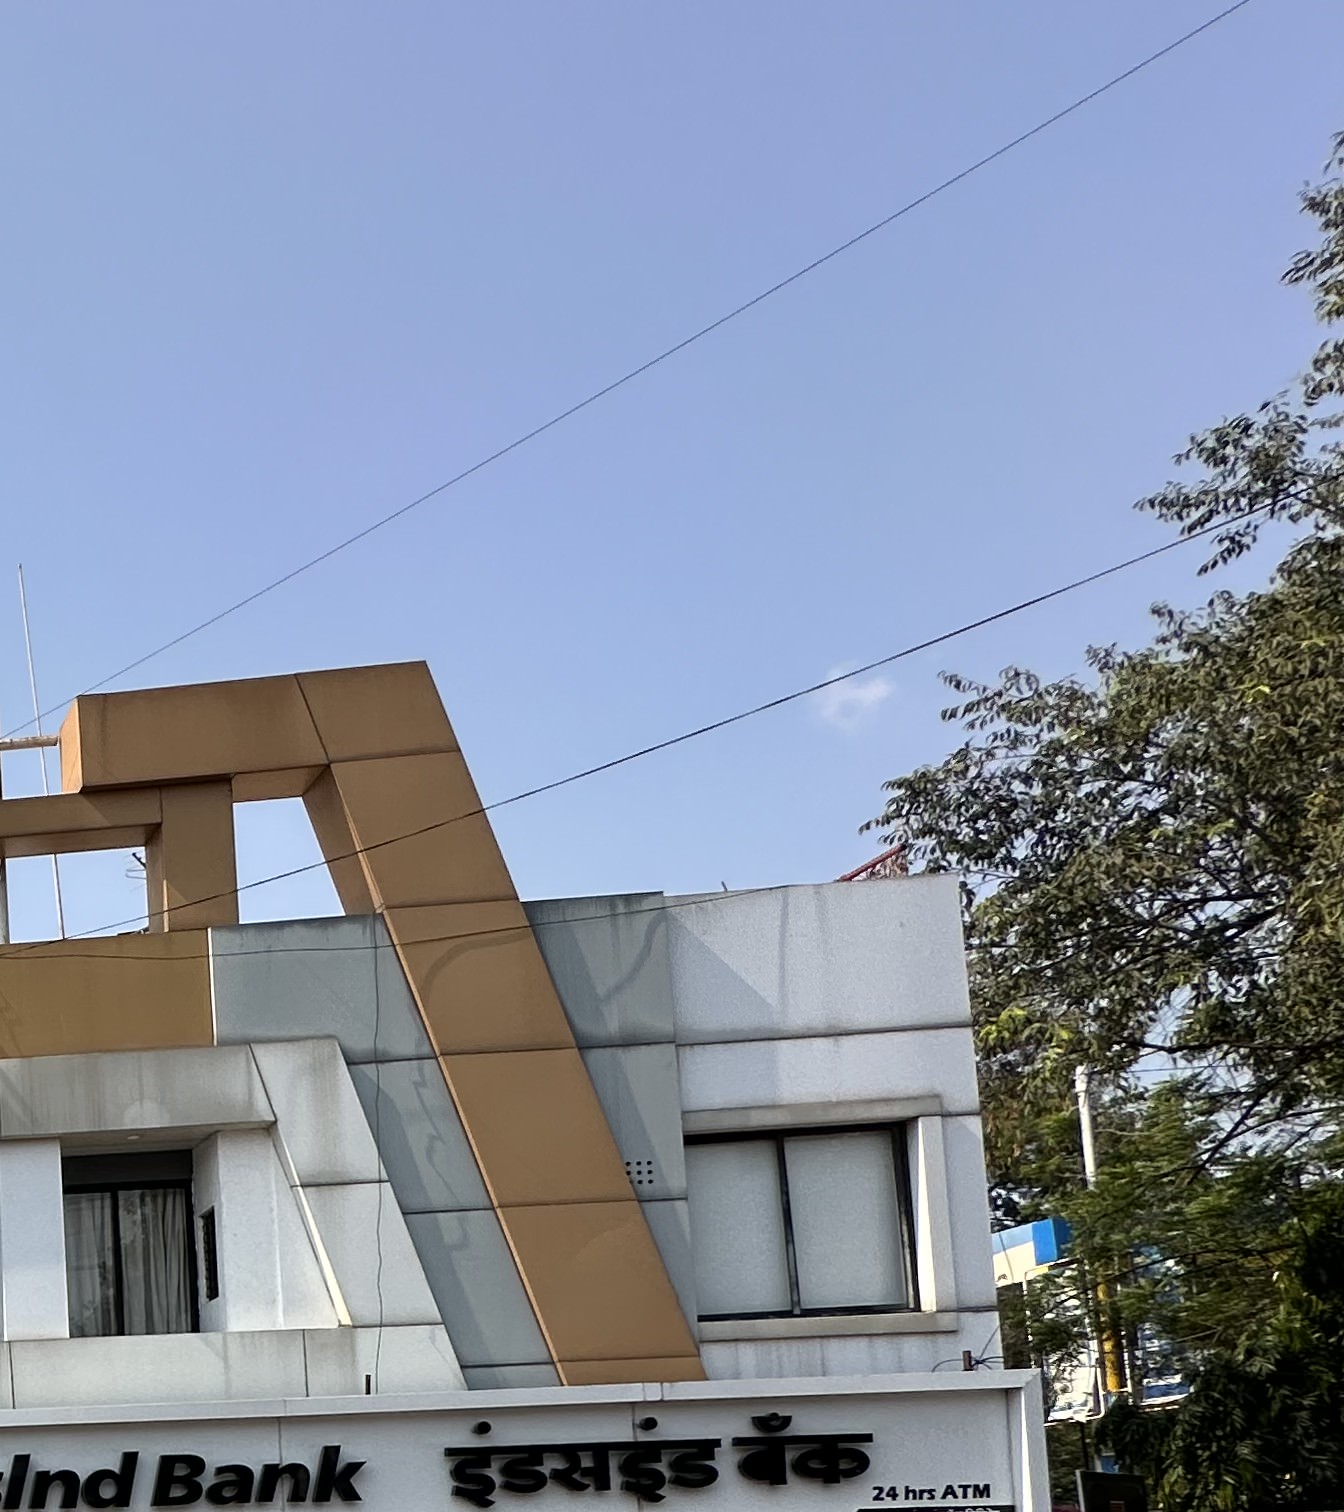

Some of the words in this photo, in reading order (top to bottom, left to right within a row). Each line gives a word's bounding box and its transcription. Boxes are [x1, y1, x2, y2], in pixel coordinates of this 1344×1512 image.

[150, 1443, 367, 1509] Bank
[444, 1418, 722, 1507] इंडसइंड
[872, 1486, 899, 1501] 24
[904, 1485, 936, 1501] hrs
[941, 1483, 991, 1500] ATM
